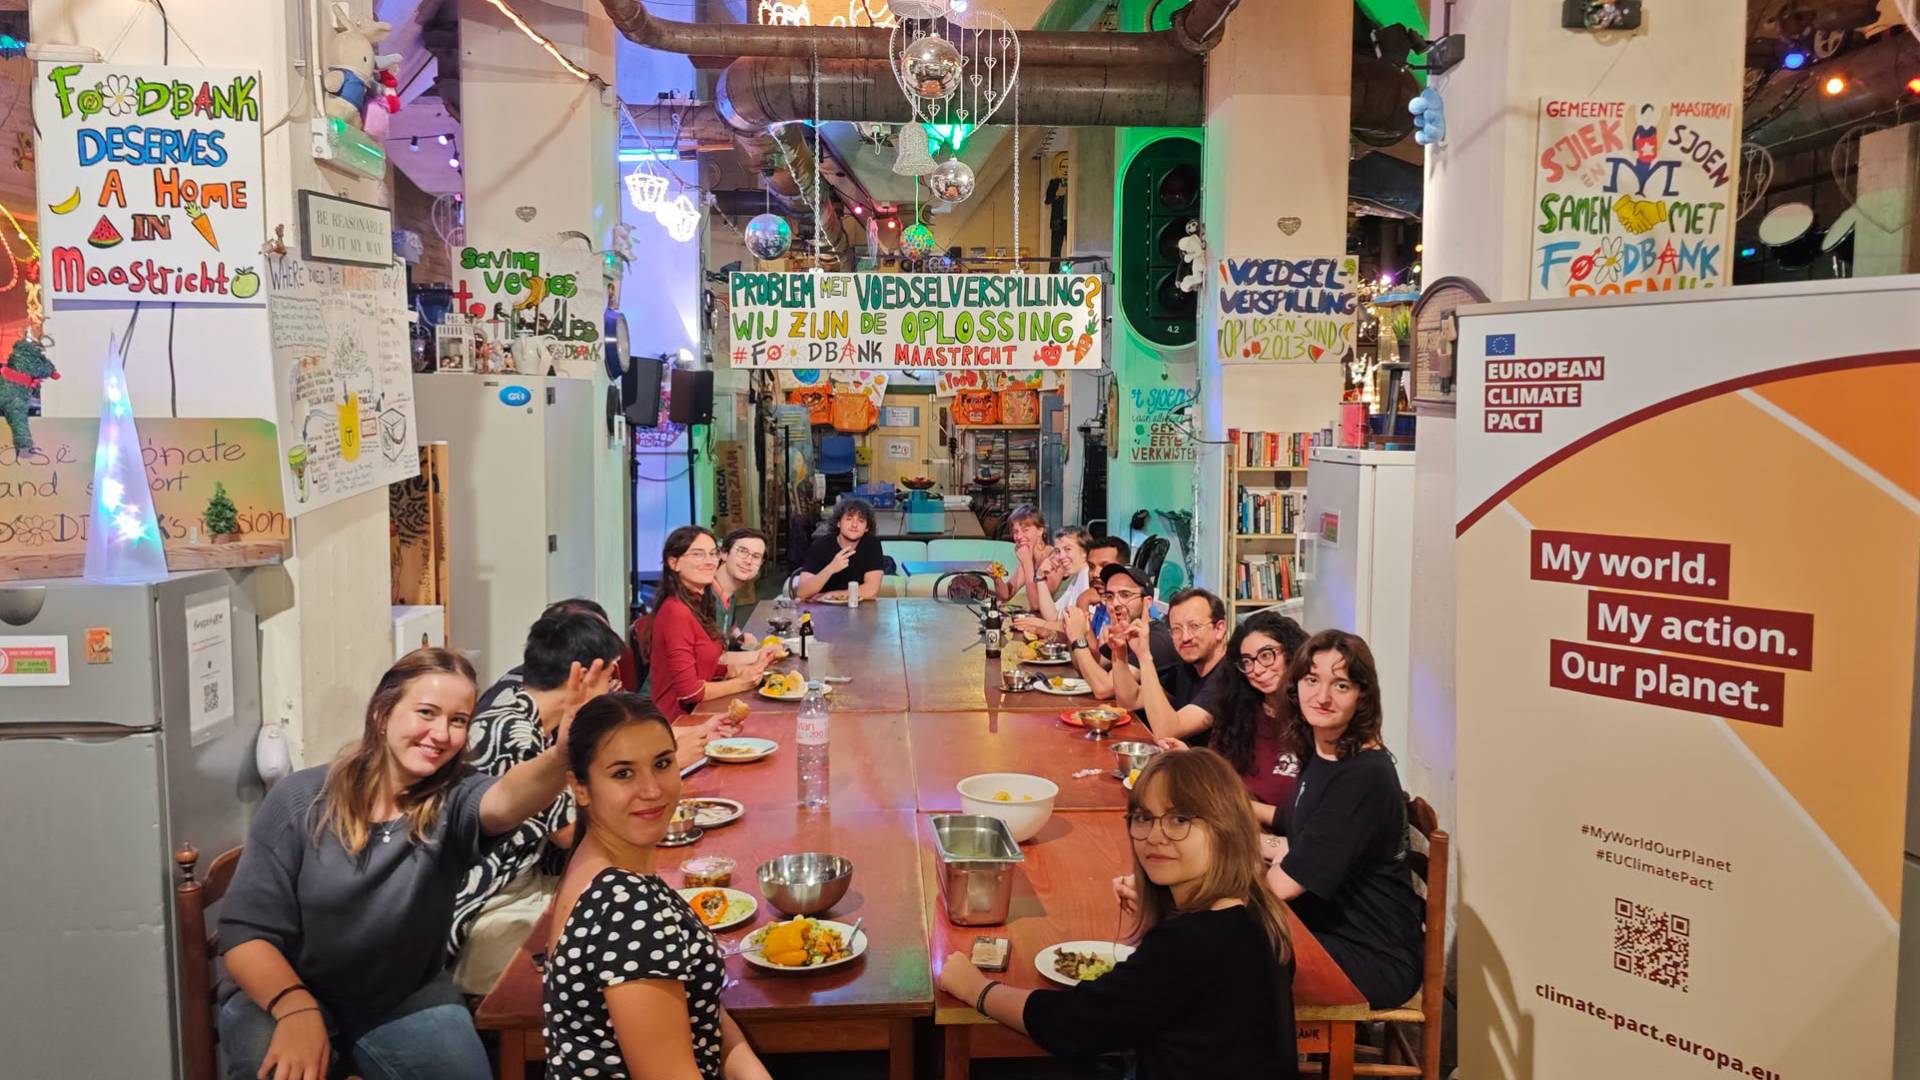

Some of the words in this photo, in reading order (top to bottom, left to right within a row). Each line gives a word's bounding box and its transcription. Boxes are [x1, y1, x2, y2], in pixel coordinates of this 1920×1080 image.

[1546, 101, 1625, 118] GEMEENTE
[1670, 102, 1732, 120] MAASTRICHT
[77, 125, 228, 168] DESERVES
[1541, 119, 1624, 183] SJIEK
[1668, 124, 1729, 189] SJOEN
[98, 168, 127, 208] A
[153, 168, 248, 209] HOME
[1581, 162, 1606, 188] EN
[131, 214, 171, 241] IN
[317, 210, 328, 225] BE
[332, 213, 385, 236] REASONABLE
[1537, 192, 1613, 235] SAMEN
[1667, 202, 1725, 235] MET
[321, 233, 334, 249] DO
[337, 236, 346, 250] IT
[351, 238, 361, 253] MY
[268, 256, 305, 291] WHERE
[731, 273, 815, 309] PROBLEM
[820, 275, 852, 300] MET
[1220, 287, 1357, 315] VERSPILLING
[732, 311, 777, 341] WIJ
[788, 310, 849, 339] ZIJN
[860, 311, 887, 336] DE
[901, 311, 1073, 347] OPLOSSING
[1167, 324, 1180, 334] 4.2
[1223, 318, 1297, 358] OPLOSSEN
[895, 344, 1017, 367] MAASTRICHT
[1258, 335, 1306, 360] 2013
[1487, 360, 1602, 379] EUROPEAN
[1487, 386, 1579, 405] CLIMATE
[636, 432, 679, 442] OCTOR
[1487, 412, 1539, 431] PACT
[0, 471, 58, 498] and
[1541, 542, 1591, 580] My
[1599, 551, 1717, 586] world.
[1597, 603, 1652, 644] My
[1660, 615, 1798, 656] action.
[1561, 651, 1625, 687] Our
[1635, 663, 1770, 711] planet.
[1581, 824, 1732, 873] #MyWorldOurPlanet
[1595, 848, 1714, 891] #EUClimatePact
[1535, 982, 1780, 1080] climate-pact.europa.eu
